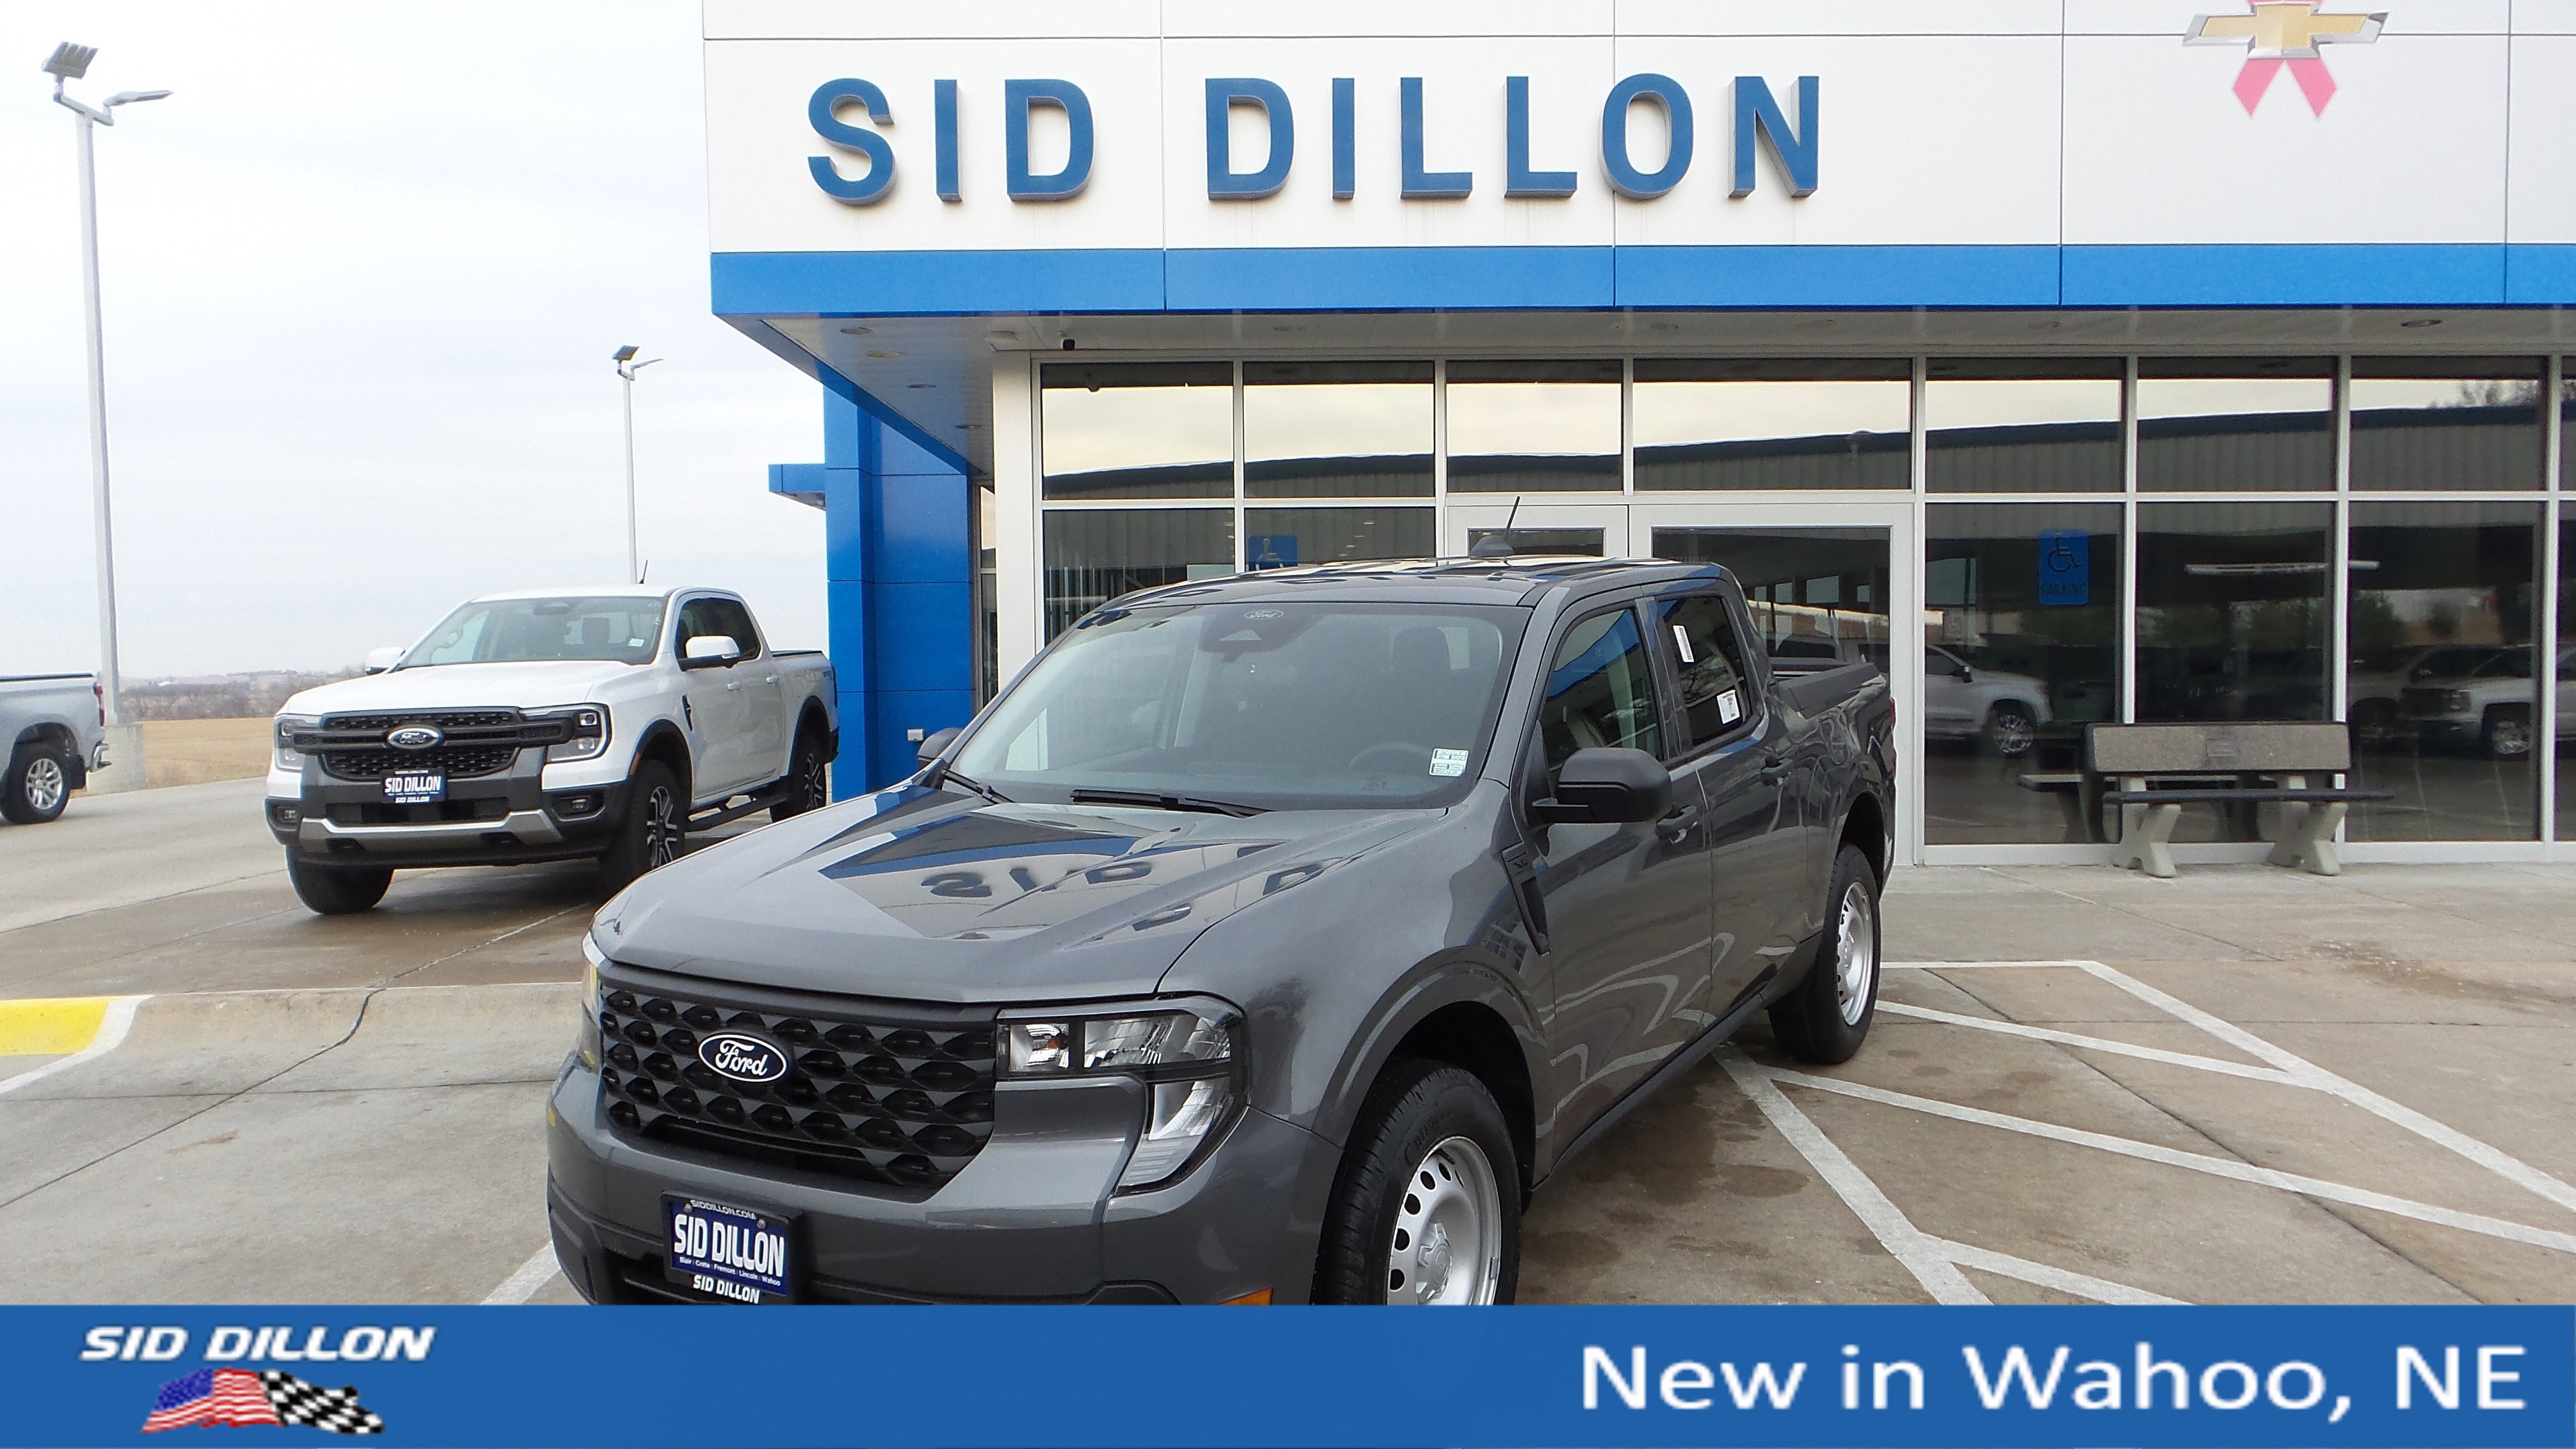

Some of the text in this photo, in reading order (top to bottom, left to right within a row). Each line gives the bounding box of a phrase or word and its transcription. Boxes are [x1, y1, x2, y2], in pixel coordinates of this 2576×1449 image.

[808, 73, 1819, 203] SID DILLON
[399, 732, 427, 744] Ford
[385, 776, 441, 793] SID DILLON
[715, 1040, 768, 1076] Ford
[674, 1214, 784, 1277] SID DILLON
[693, 1275, 760, 1304] SID DILLON
[714, 1264, 736, 1275] Fremont
[739, 1270, 758, 1280] Lincoln
[761, 1276, 781, 1286] Wahoo
